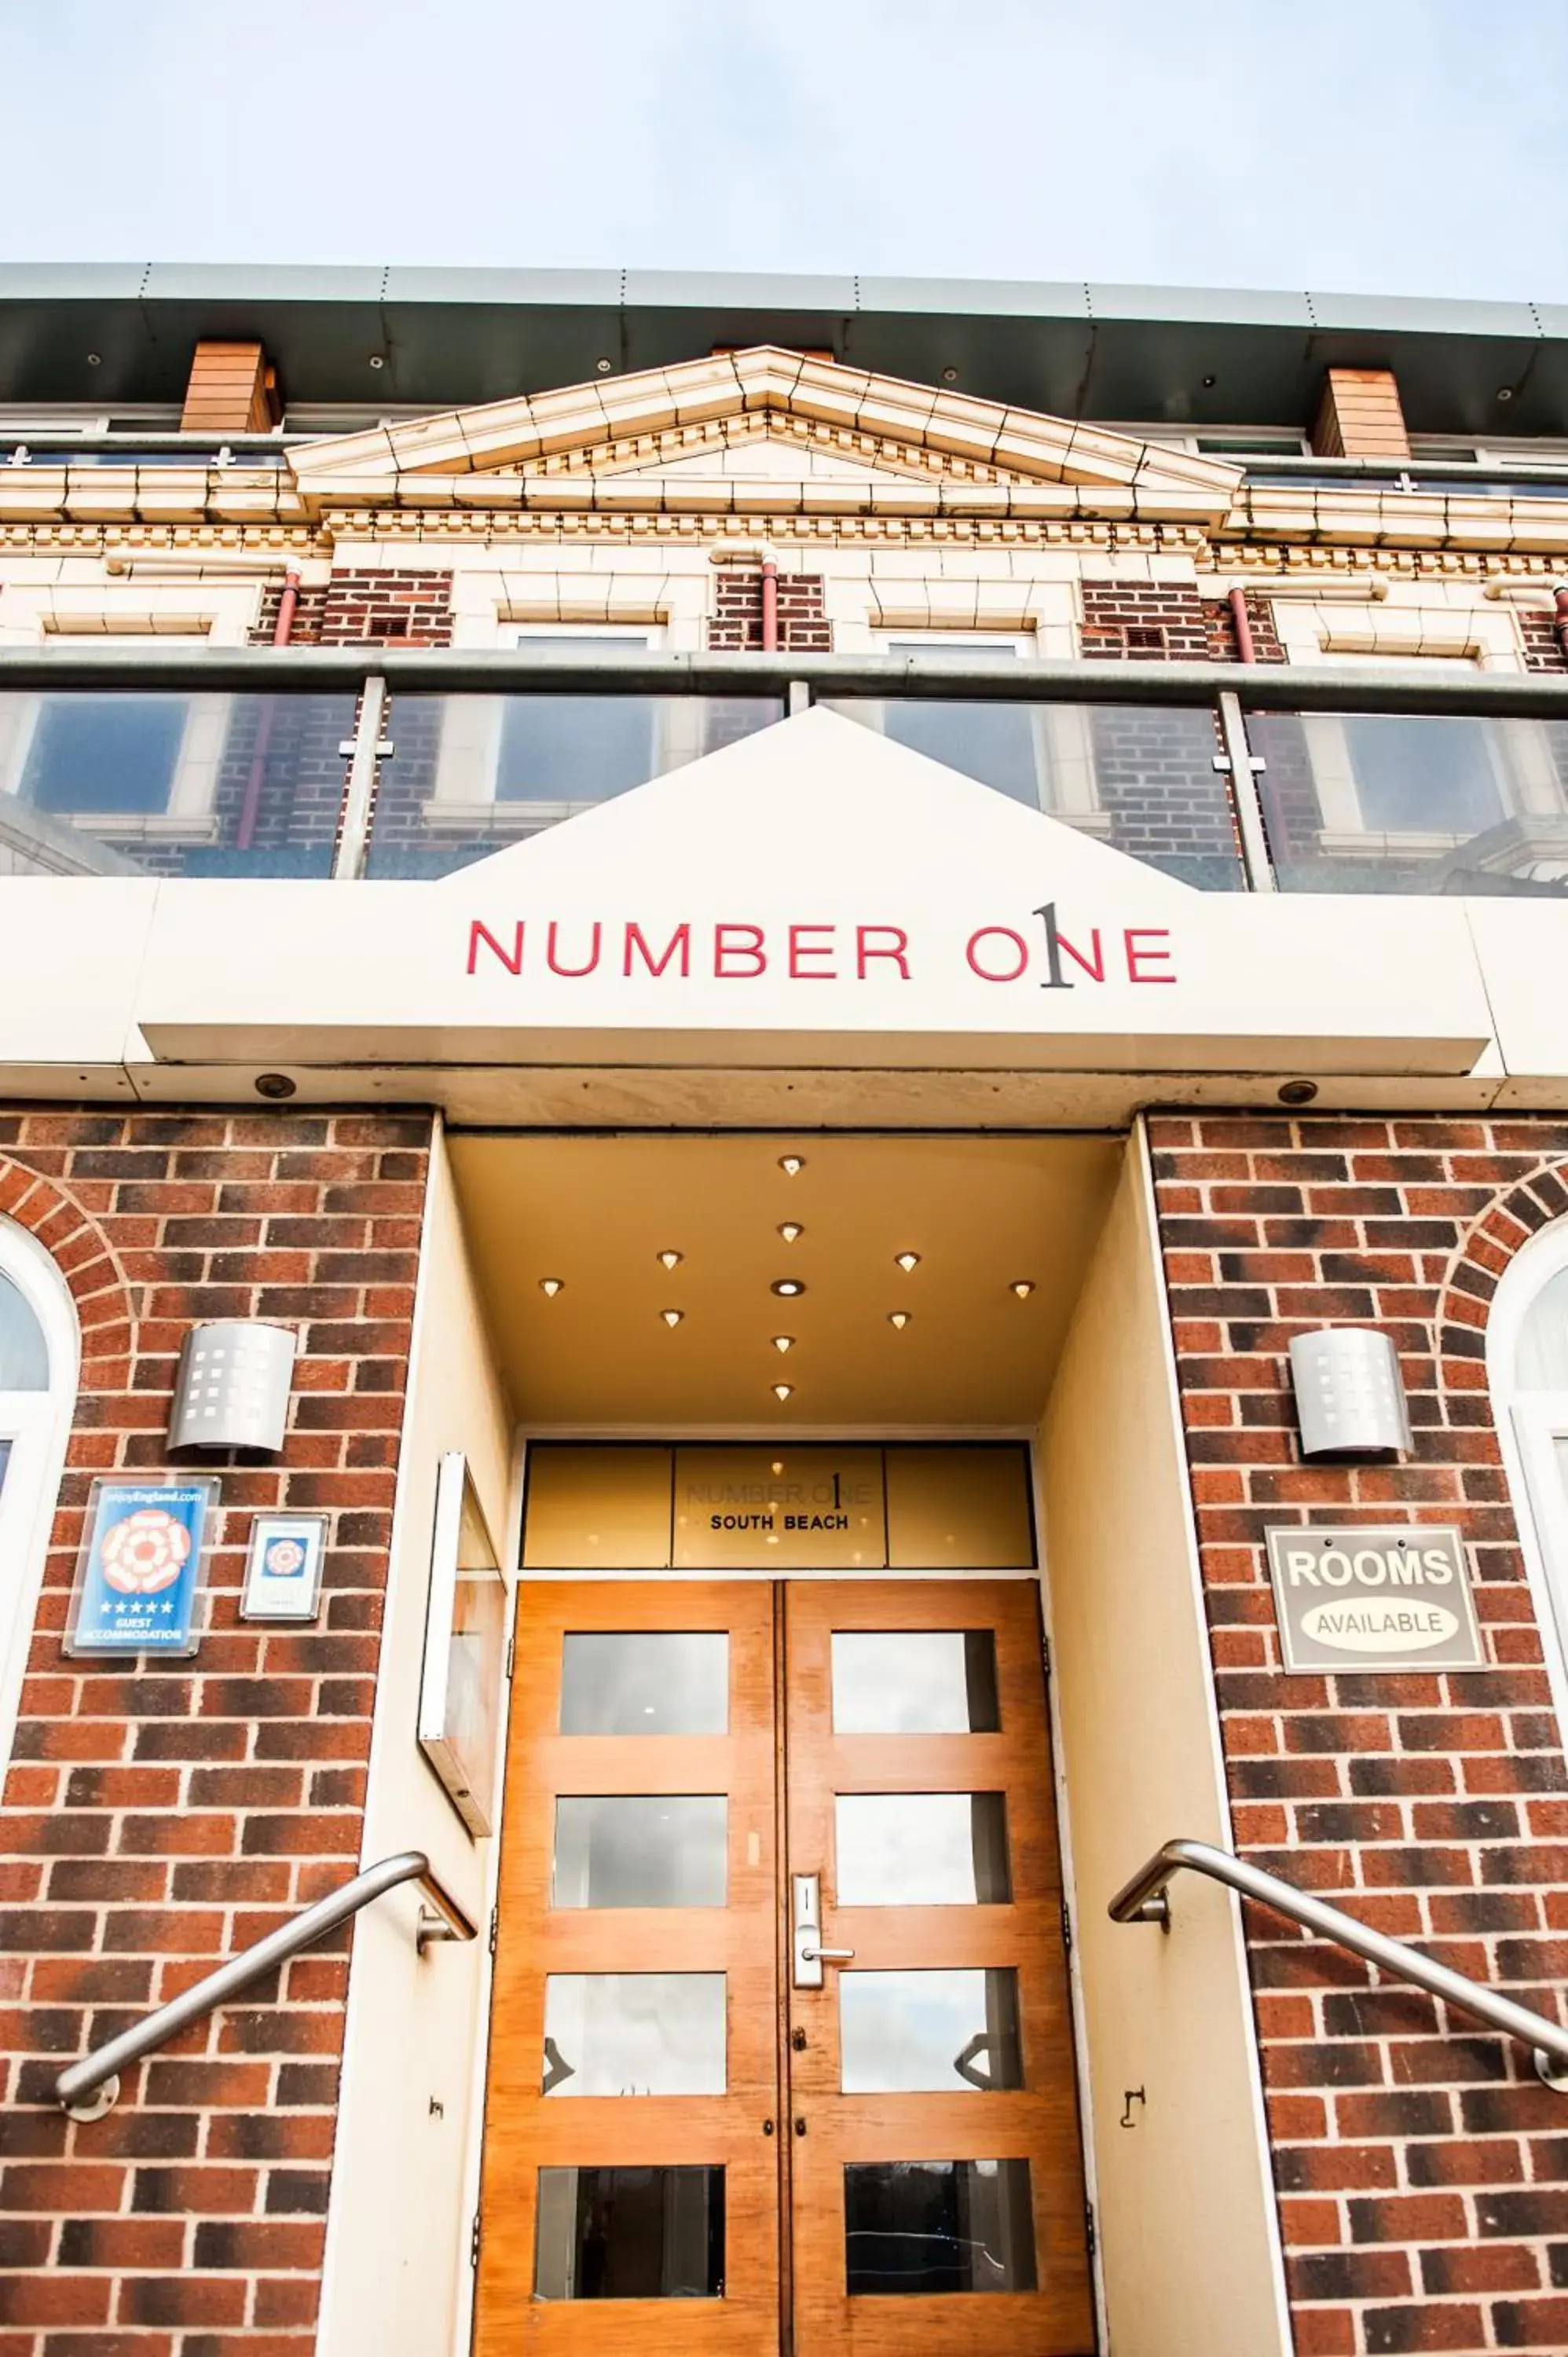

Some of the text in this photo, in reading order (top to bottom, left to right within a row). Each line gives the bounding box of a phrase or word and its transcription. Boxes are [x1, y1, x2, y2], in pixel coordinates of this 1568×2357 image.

[467, 920, 910, 980] NUMBER
[687, 1483, 804, 1505] NUMBER
[711, 1515, 848, 1530] SOUTH BEACH
[1286, 1549, 1453, 1587] ROOMS
[115, 1618, 153, 1629] GUEST
[1317, 1612, 1444, 1634] AVAILABLE
